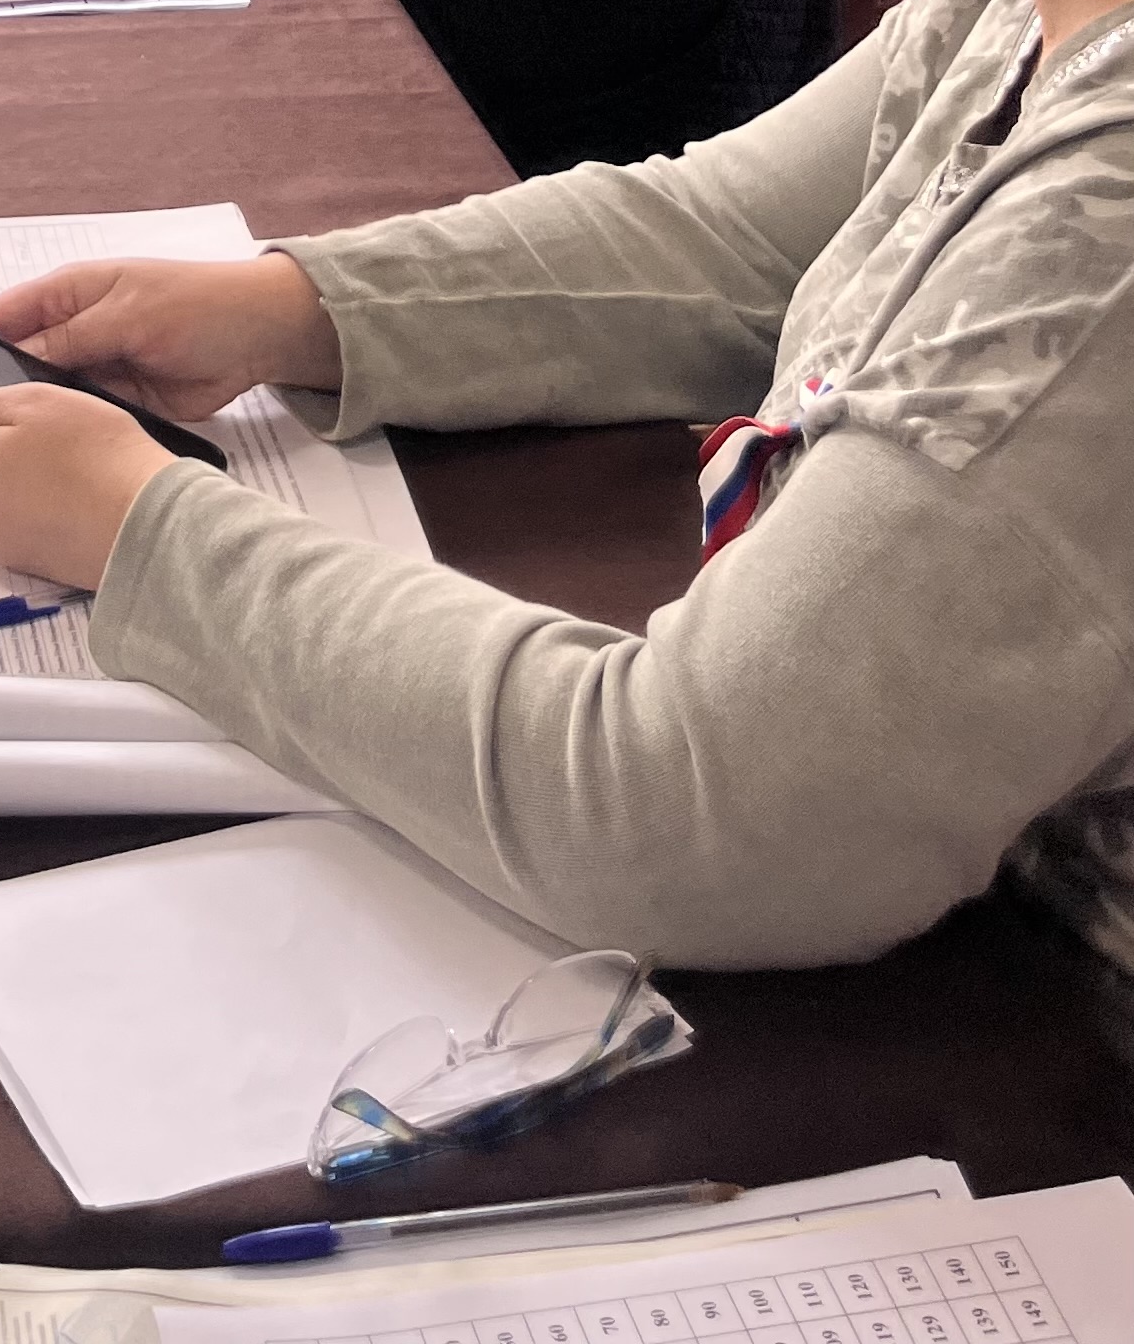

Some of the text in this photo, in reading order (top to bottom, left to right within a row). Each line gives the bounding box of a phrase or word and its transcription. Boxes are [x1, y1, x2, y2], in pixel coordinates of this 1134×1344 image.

[798, 1282, 824, 1307] 110
[946, 1258, 999, 1335] 139 140
[994, 1251, 1049, 1327] 149 150
[701, 1301, 721, 1319] 90
[749, 1289, 773, 1315] 100
[848, 1274, 894, 1344] 19 120
[897, 1266, 948, 1343] 129 130
[599, 1316, 619, 1336] 70
[650, 1309, 671, 1327] 80
[548, 1324, 568, 1342] 60
